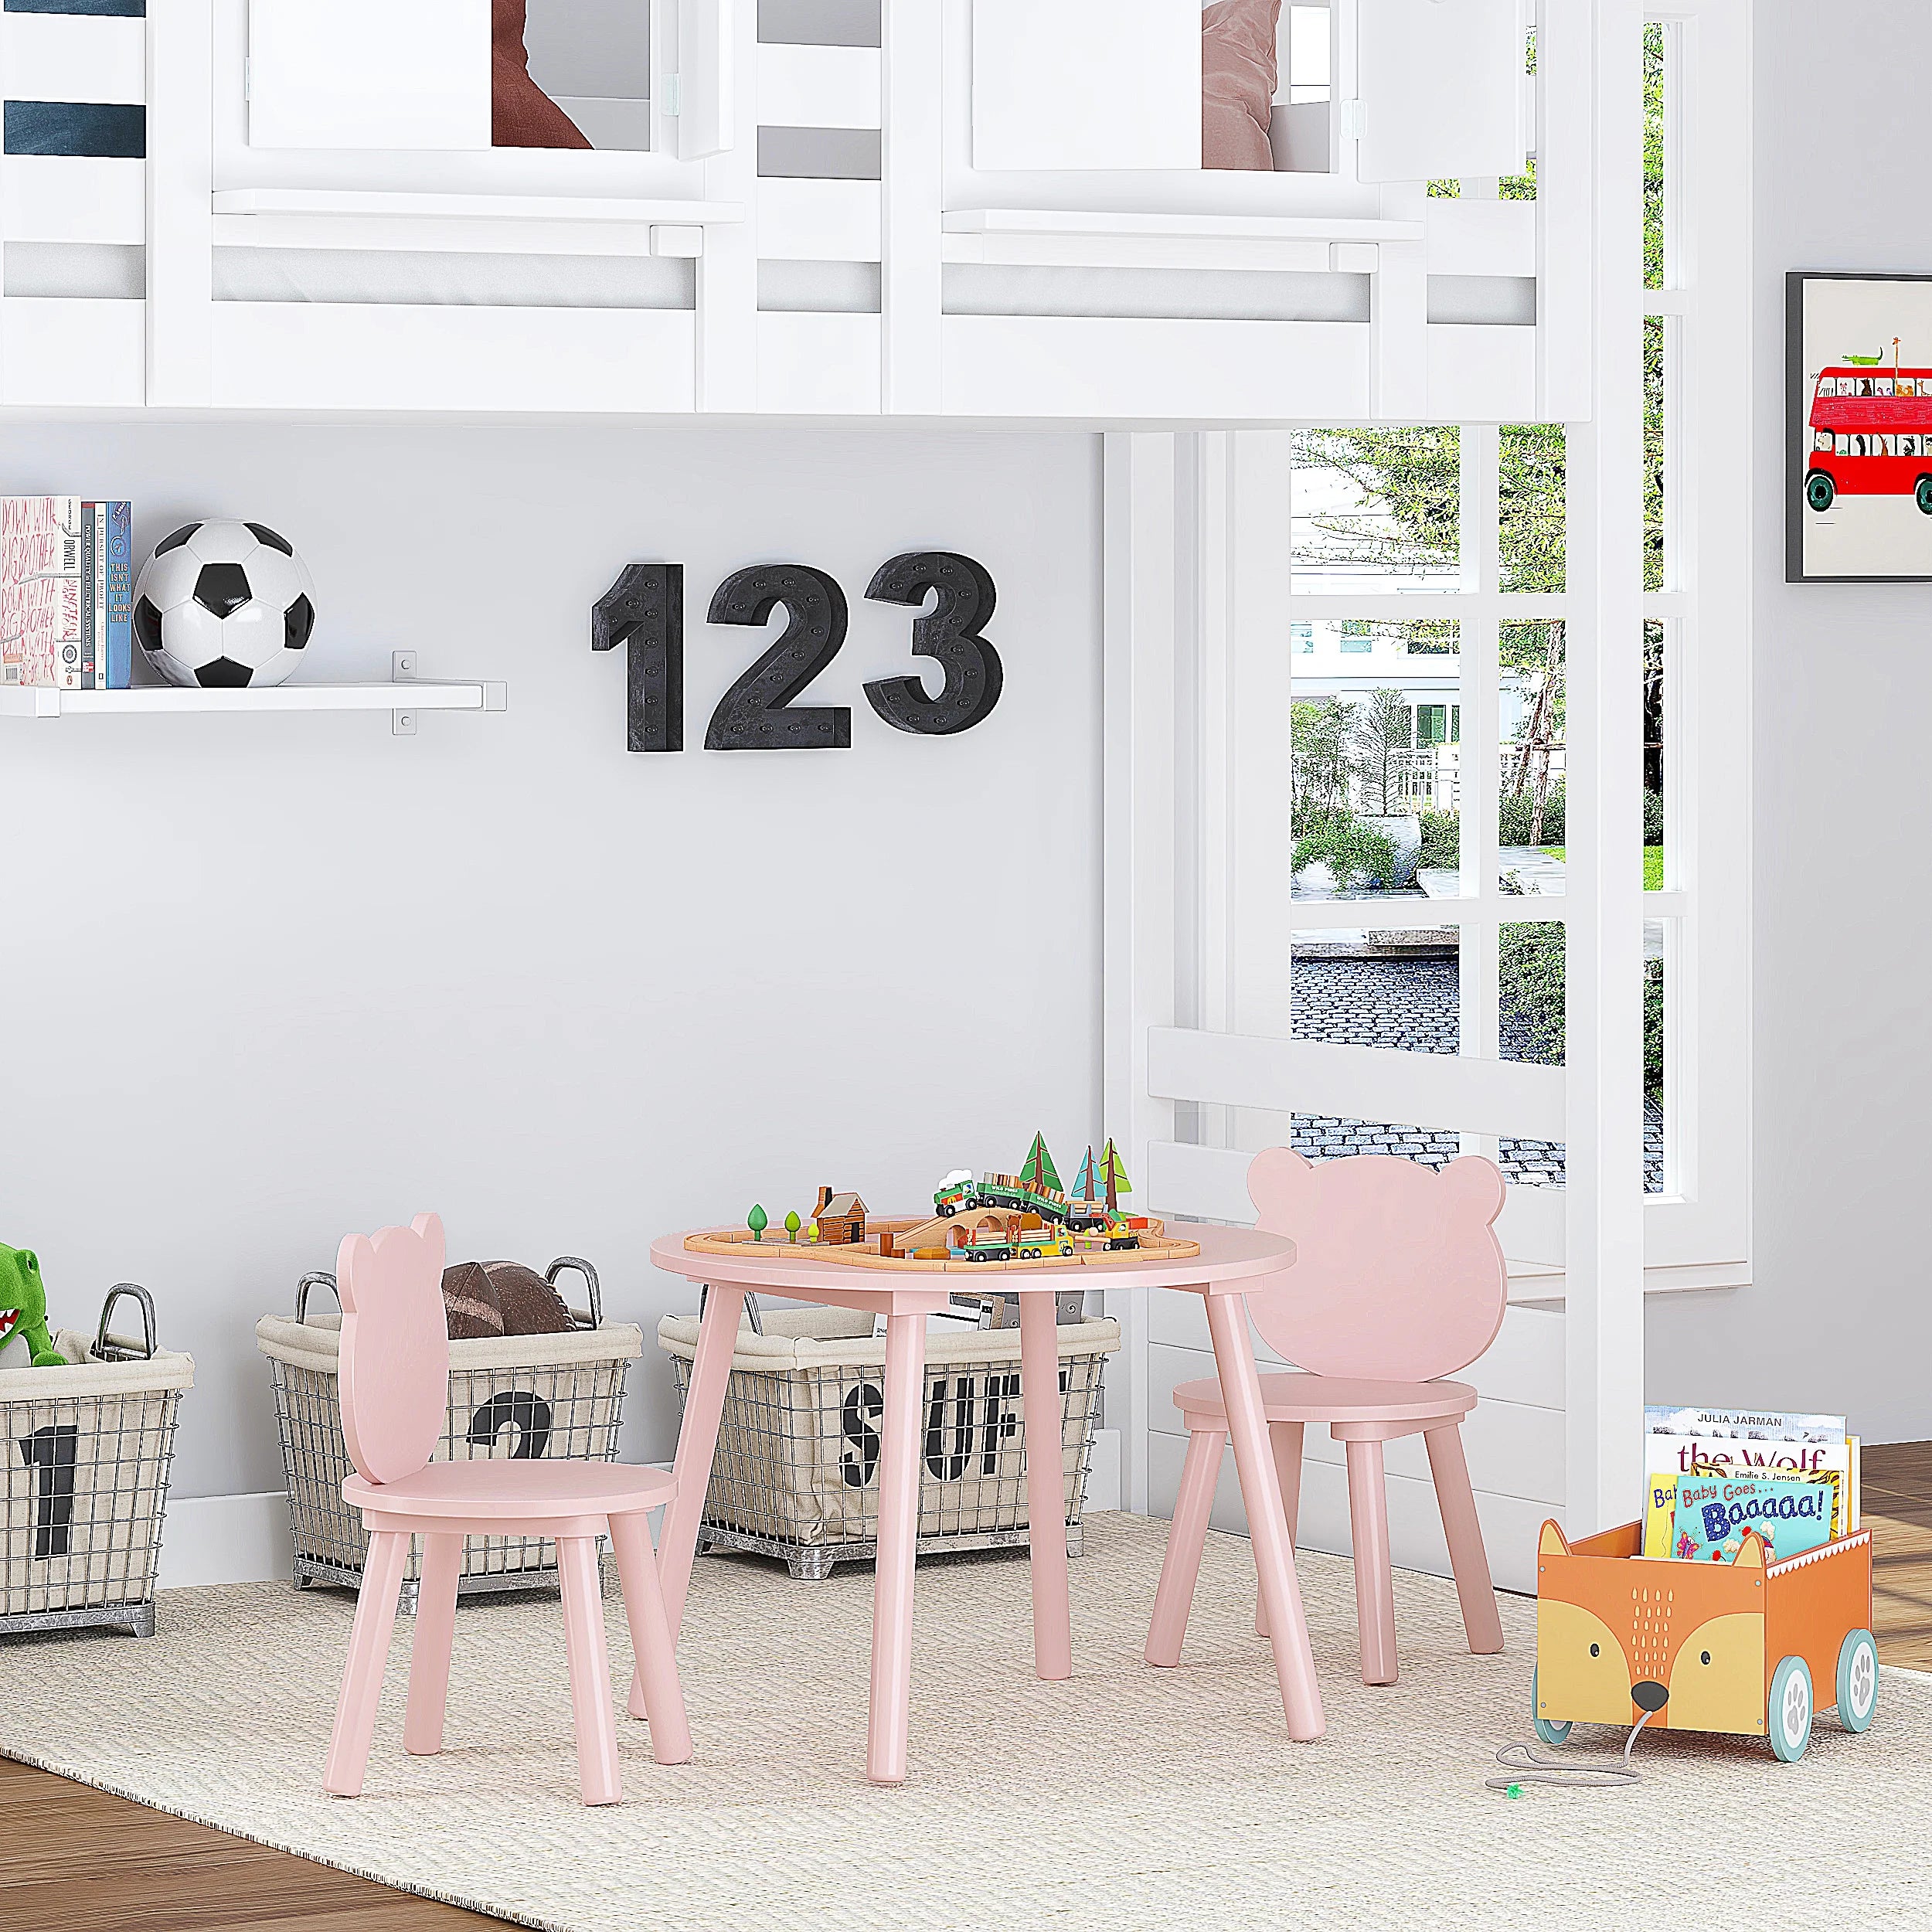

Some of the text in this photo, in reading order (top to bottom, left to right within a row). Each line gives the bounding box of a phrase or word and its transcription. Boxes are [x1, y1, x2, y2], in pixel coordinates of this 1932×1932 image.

[2, 498, 30, 536] DOWN
[2, 533, 55, 584] BIG BROTHER
[63, 540, 76, 571] ORWELL
[99, 565, 104, 576] OF
[111, 563, 128, 572] THIS
[110, 583, 131, 592] WHAT
[115, 594, 123, 602] IT
[109, 604, 131, 612] LOOKS
[111, 614, 128, 622] LIKE
[1698, 1413, 1782, 1427] JULIA JARMAN
[1677, 1442, 1731, 1472] the
[1735, 1471, 1759, 1479] Emilie
[1682, 1484, 1717, 1509] Baby
[1701, 1490, 1824, 1543] Baaaaa!
